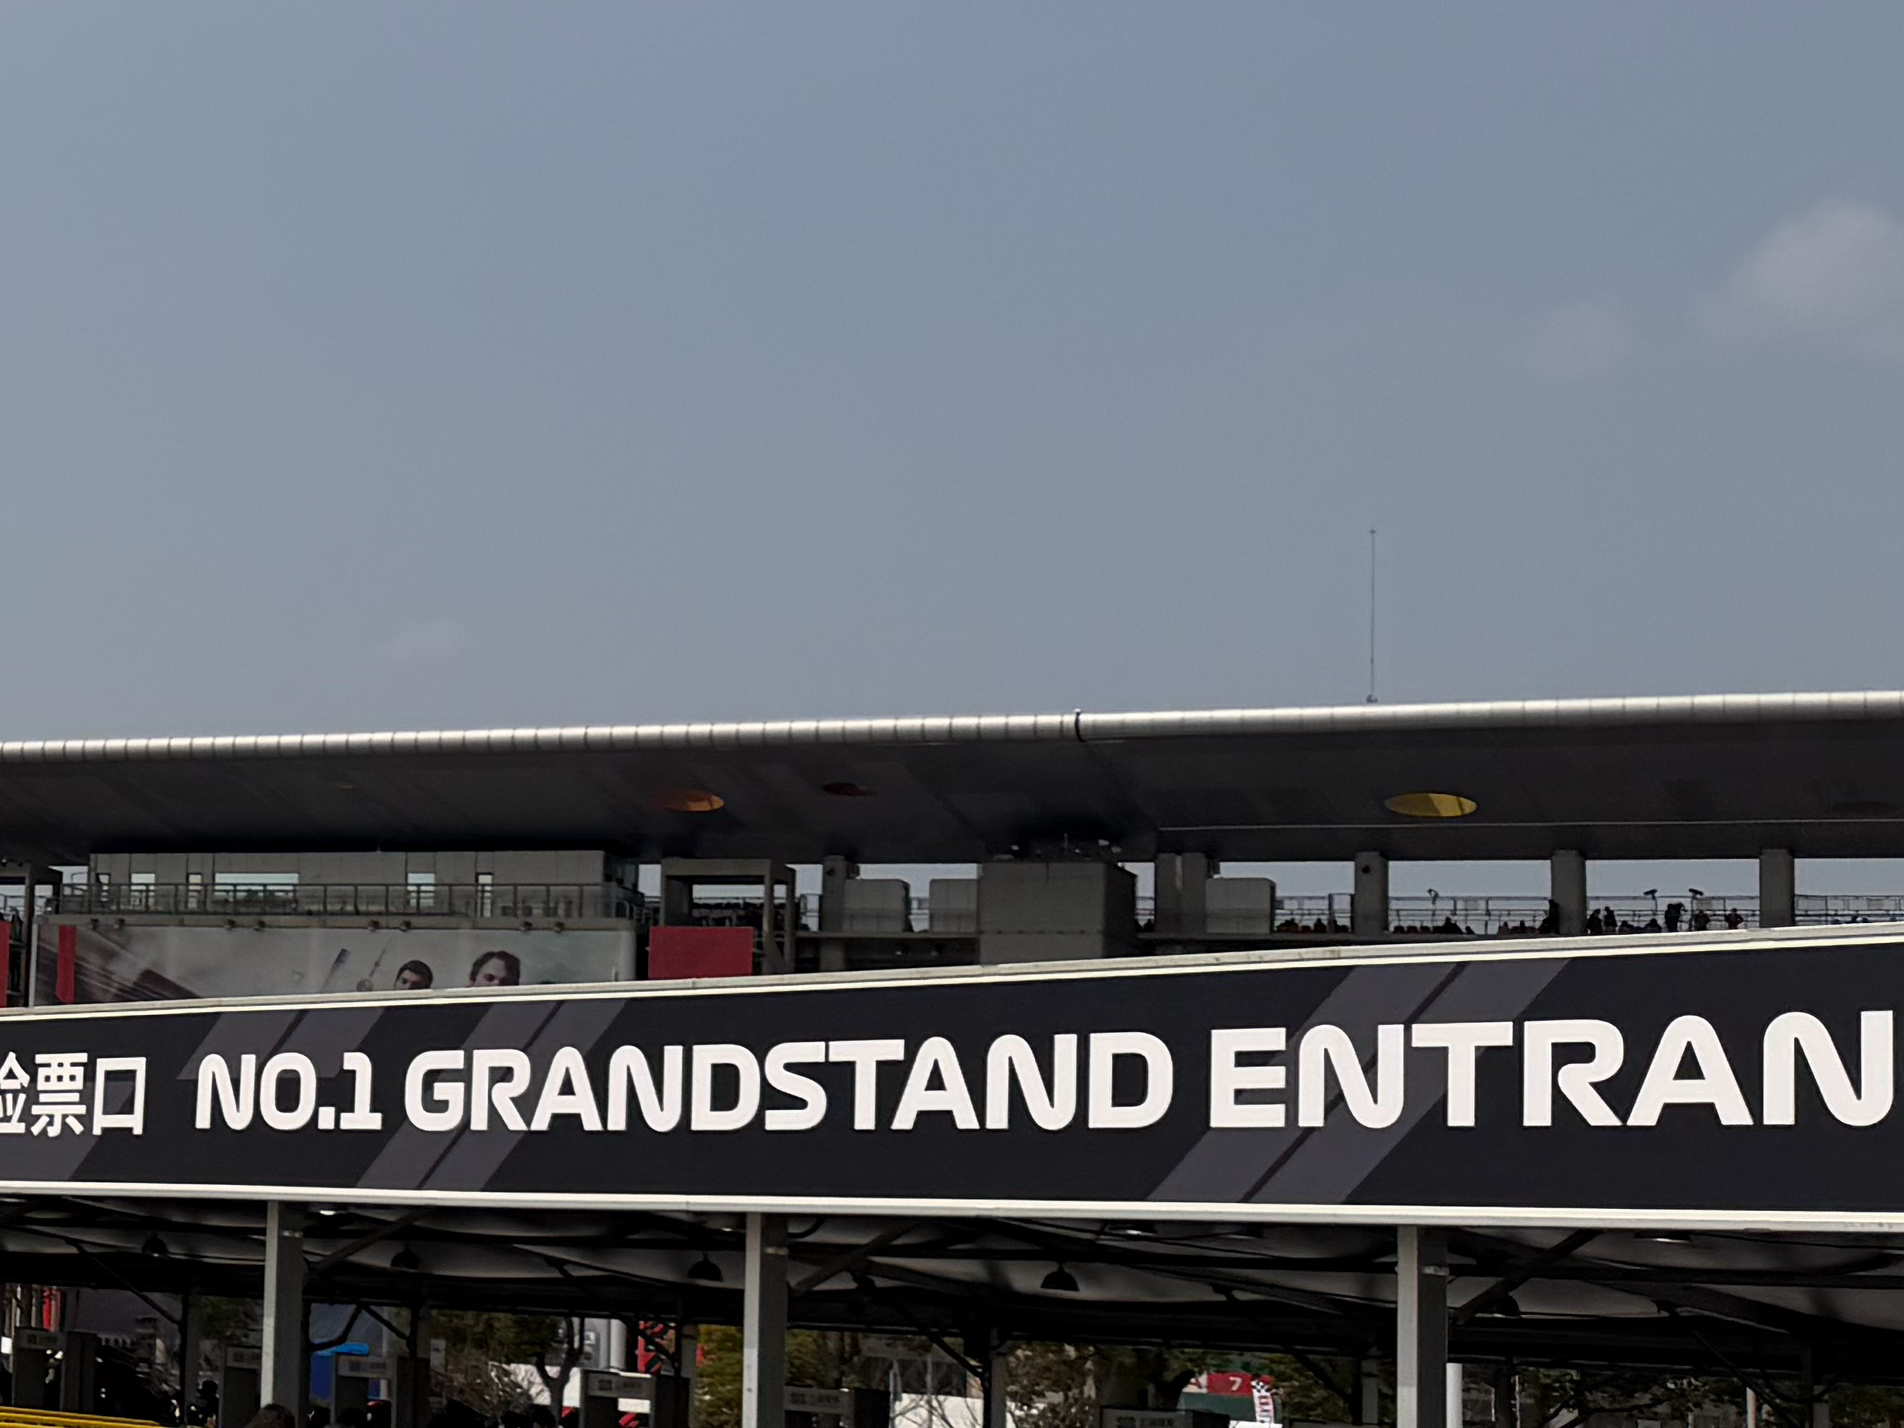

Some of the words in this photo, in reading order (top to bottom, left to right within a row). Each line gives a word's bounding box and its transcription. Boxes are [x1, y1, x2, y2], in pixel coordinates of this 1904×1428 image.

[195, 1051, 383, 1131] NO.1
[404, 1031, 1174, 1132] GRANDSTAND
[1209, 1010, 1894, 1129] ENTRAN
